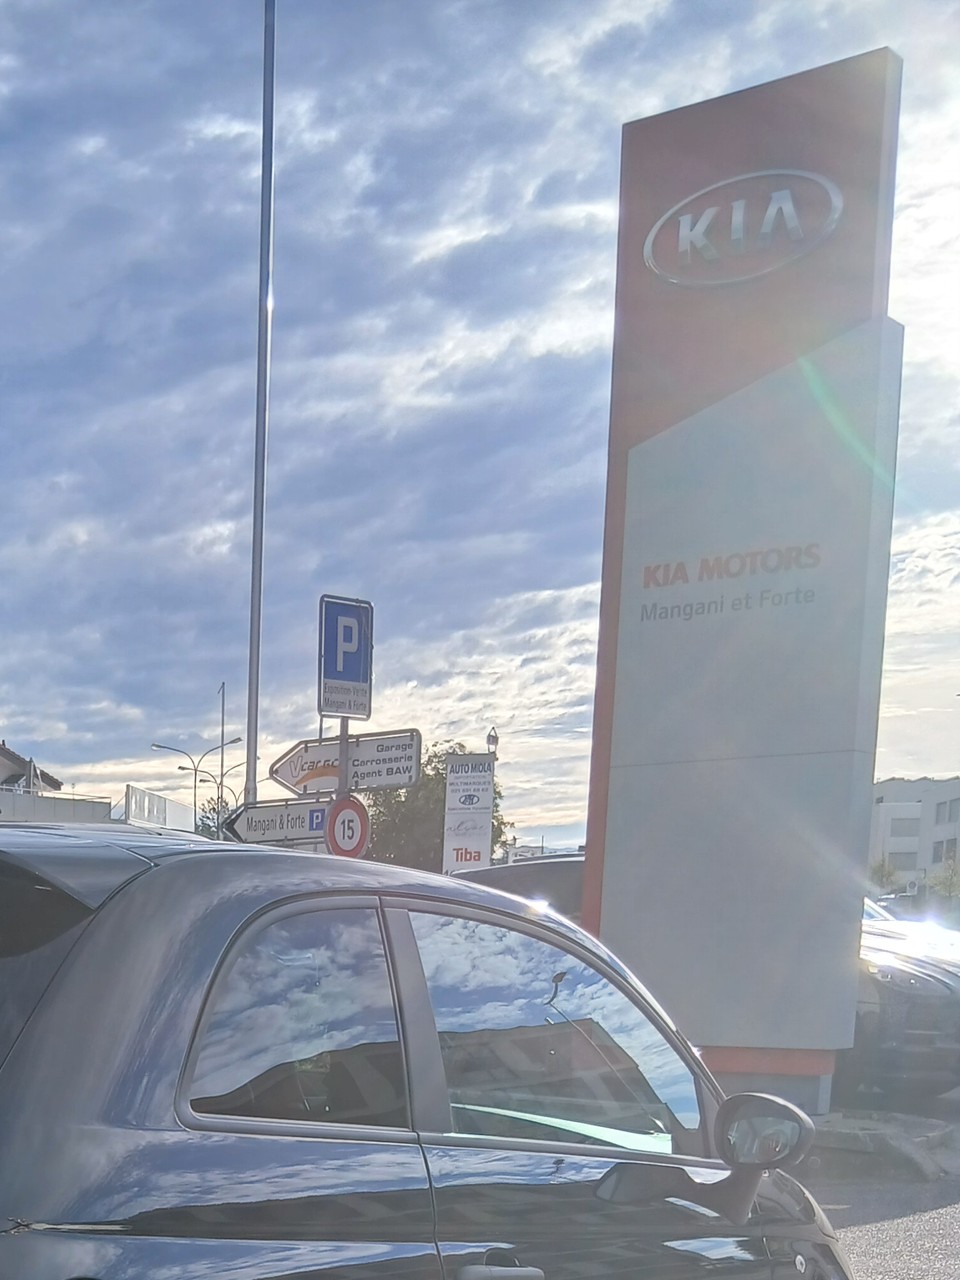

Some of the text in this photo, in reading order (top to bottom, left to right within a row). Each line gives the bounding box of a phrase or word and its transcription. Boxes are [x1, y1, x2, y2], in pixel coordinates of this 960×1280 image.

[677, 189, 804, 265] KIA
[643, 543, 821, 589] KIA MOTORS
[640, 586, 816, 621] Mangani et Forte
[337, 616, 359, 672] P
[325, 697, 347, 711] Mangani
[353, 700, 367, 711] Forte
[376, 743, 413, 753] Garage
[352, 754, 413, 767] Carrosserie
[449, 763, 470, 774] AUTO
[352, 765, 413, 780] Agent BAW
[246, 812, 322, 835] Mangani & Forte P
[340, 819, 355, 840] 15
[452, 848, 481, 862] Tiba
